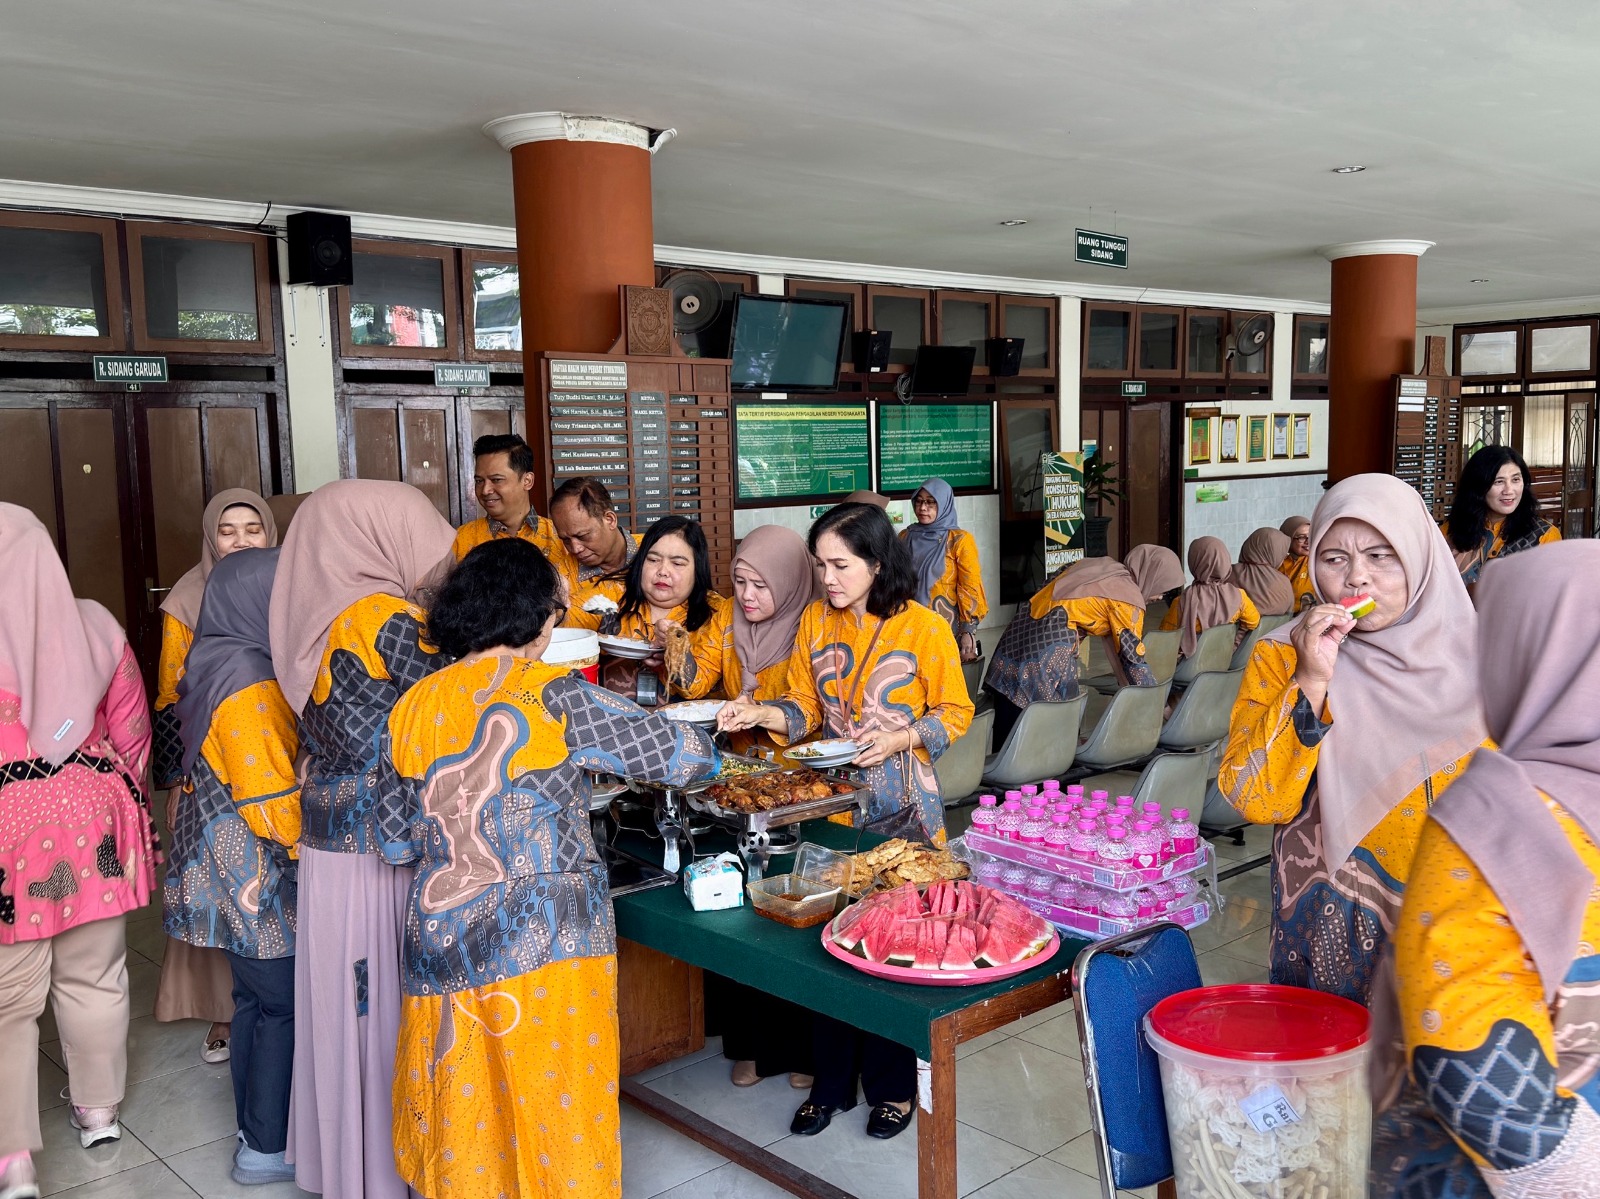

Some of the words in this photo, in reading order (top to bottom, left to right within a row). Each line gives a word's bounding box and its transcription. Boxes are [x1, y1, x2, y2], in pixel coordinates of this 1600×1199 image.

[1078, 236, 1100, 247] RUANG
[1101, 240, 1126, 251] TUNGGU
[1091, 249, 1113, 260] SIDANG
[99, 362, 106, 376] R.
[108, 362, 133, 376] SIDANG
[134, 362, 162, 377] GARUDA
[444, 369, 463, 381] SIDANG
[464, 369, 487, 381] KARTIKA
[1046, 484, 1078, 494] KONSULTASI
[1052, 495, 1079, 509] HUKUM
